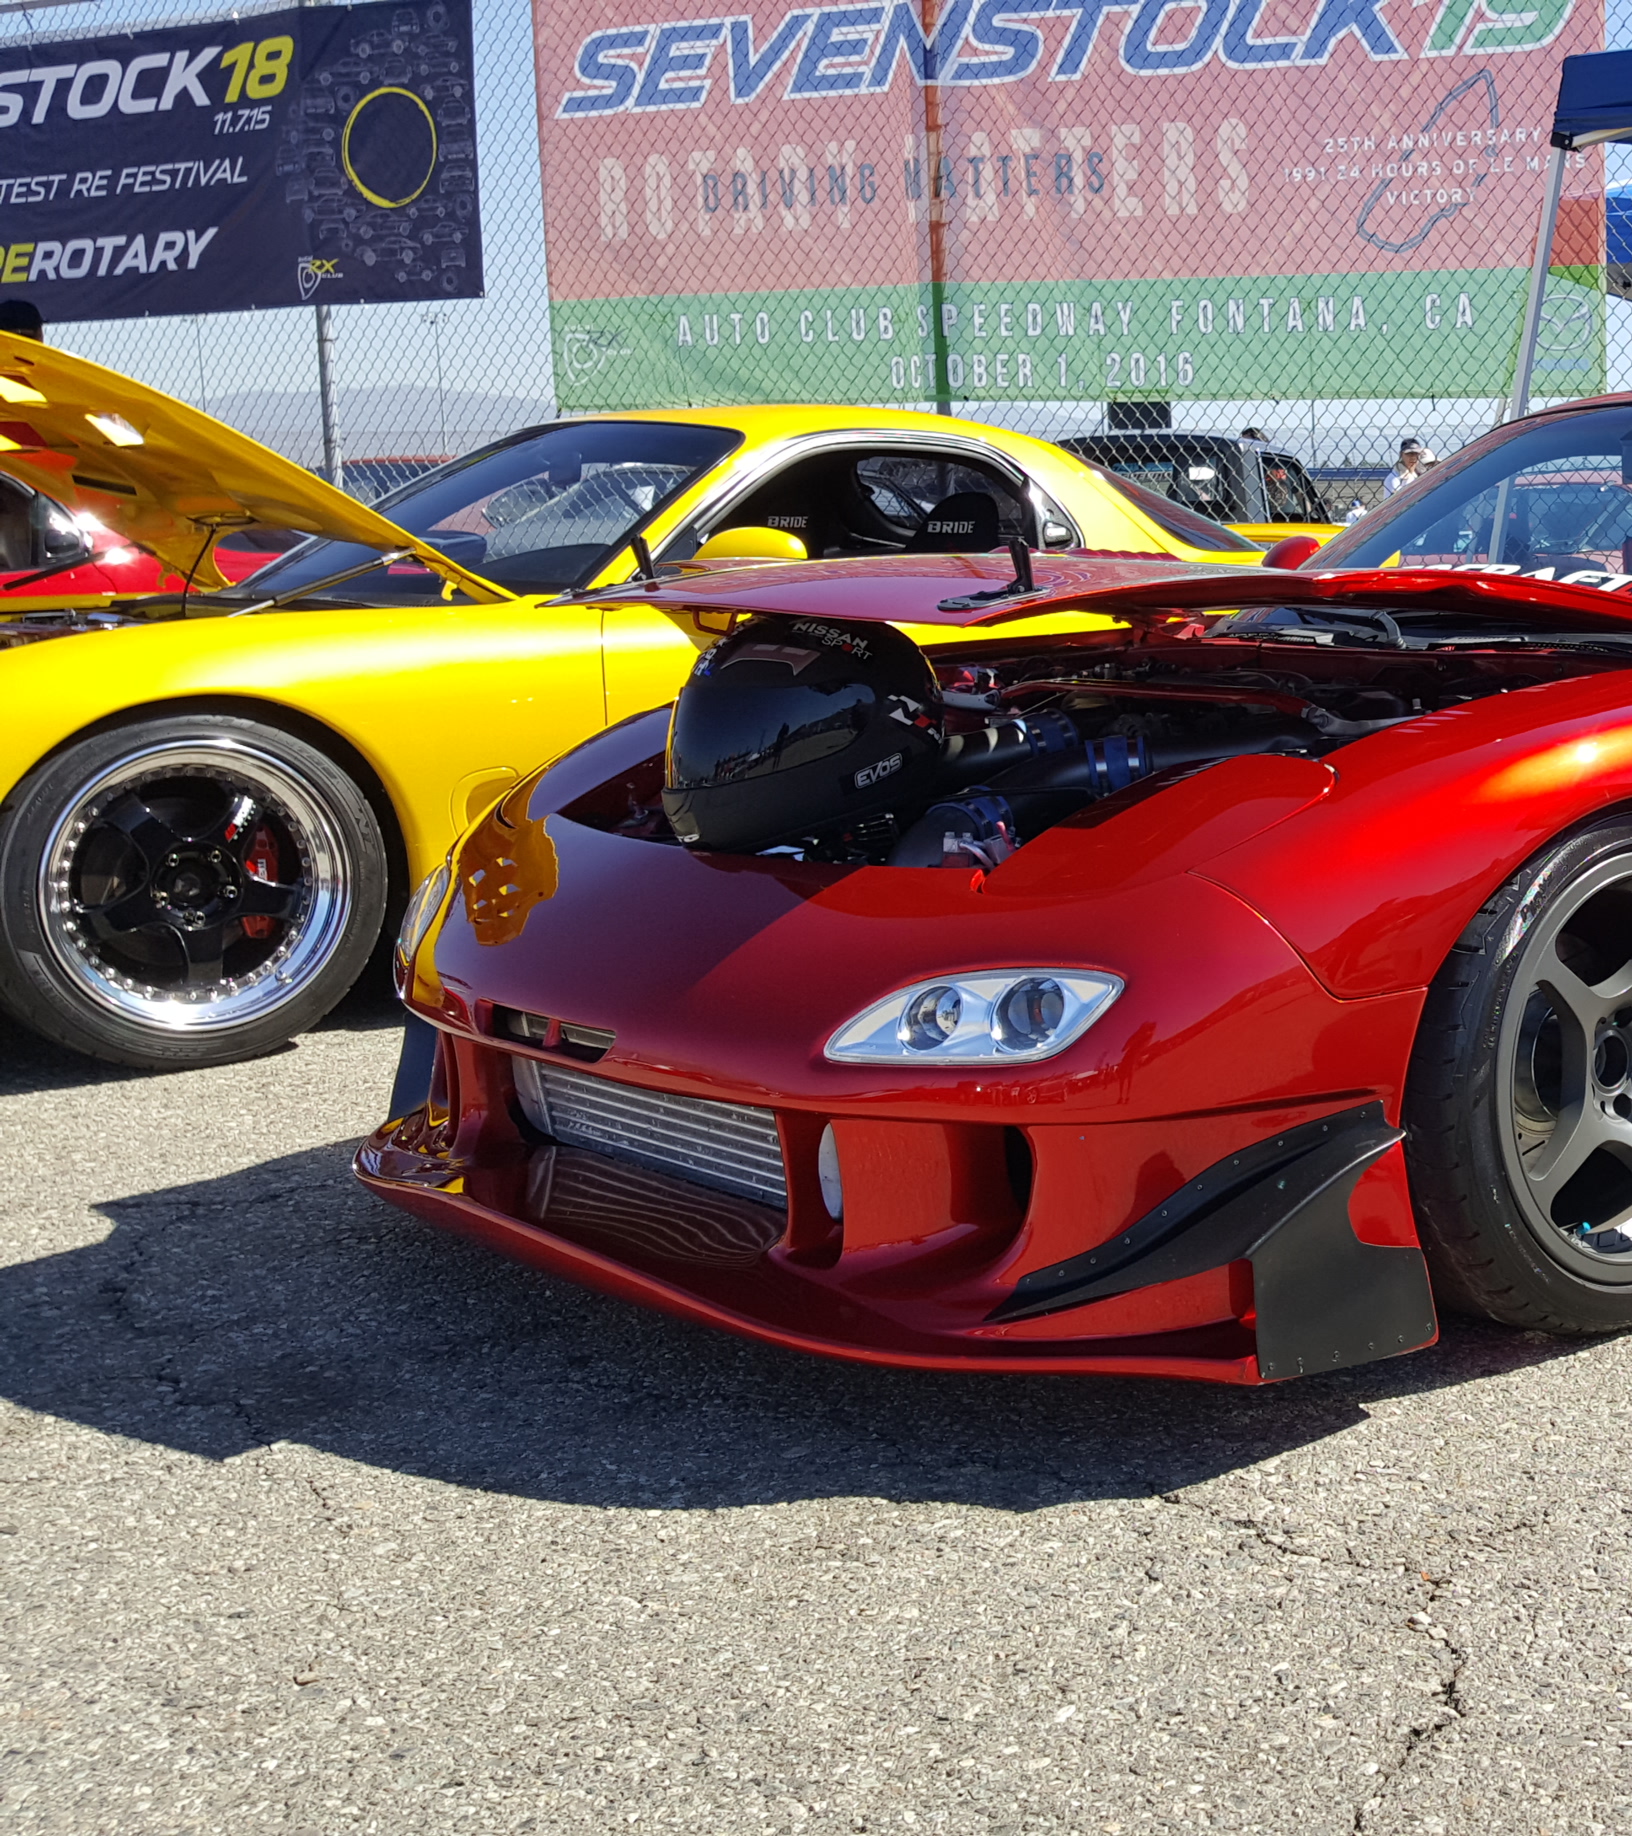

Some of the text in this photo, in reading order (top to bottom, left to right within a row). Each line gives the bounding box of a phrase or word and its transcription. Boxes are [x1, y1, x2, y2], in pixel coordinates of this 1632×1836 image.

[213, 105, 272, 135] 11.7.15
[1324, 126, 1542, 153] 25TH ANNIVERSARY
[70, 169, 112, 198] RE
[116, 156, 248, 195] FESTIVAL
[1284, 166, 1327, 182] 1991
[1337, 164, 1361, 180] 24
[1371, 160, 1441, 178] HOURS
[1453, 158, 1478, 174] OF
[1490, 156, 1514, 173] LE
[702, 162, 877, 214] DRIVING
[1387, 187, 1477, 205] VICTORY
[0, 226, 218, 283] EROTARY
[677, 291, 1475, 347] AUTO CLUB SPEEDWAY FONTANA, CA
[890, 352, 1034, 391] OCTOBER
[1105, 350, 1196, 388] 2016
[767, 515, 809, 528] BRIDE
[927, 520, 976, 534] BRIDE
[793, 622, 869, 650] NISSAN
[856, 754, 901, 787] EVOS
